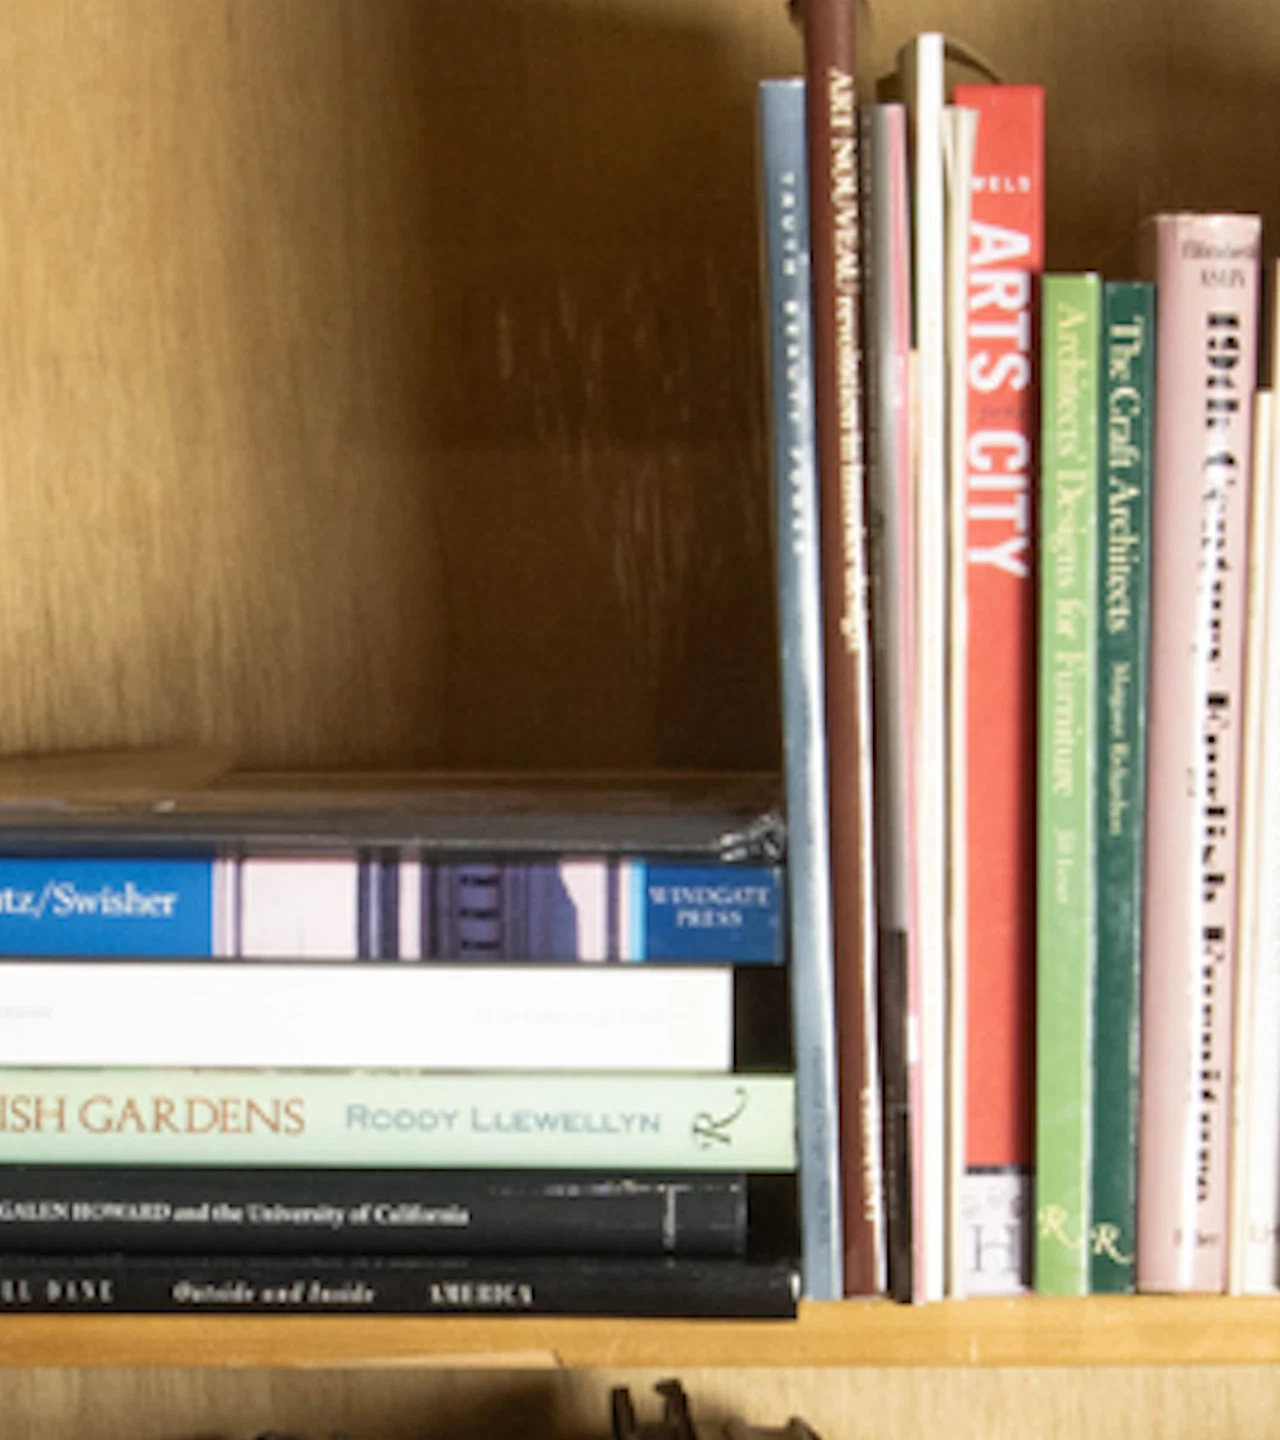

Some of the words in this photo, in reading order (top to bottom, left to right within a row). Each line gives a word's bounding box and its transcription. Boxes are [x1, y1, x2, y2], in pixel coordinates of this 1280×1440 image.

[968, 222, 1031, 391] ARTS
[1107, 317, 1142, 386] The
[1053, 304, 1091, 462] Architects'
[1105, 395, 1140, 479] Craft
[968, 432, 1029, 577] CITY
[1044, 470, 1089, 590] Designs
[1104, 484, 1138, 634] Architects
[1049, 599, 1083, 639] for
[1047, 649, 1082, 796] Furniture
[79, 1095, 305, 1137] GARDENS
[344, 1106, 459, 1135] RODDY
[469, 1106, 663, 1135] LLEWELLYN
[72, 1202, 169, 1224] HOWARD
[174, 1206, 209, 1224] and
[212, 1205, 243, 1226] the
[248, 1203, 338, 1230] University
[341, 1206, 368, 1228] of
[371, 1205, 469, 1227] California
